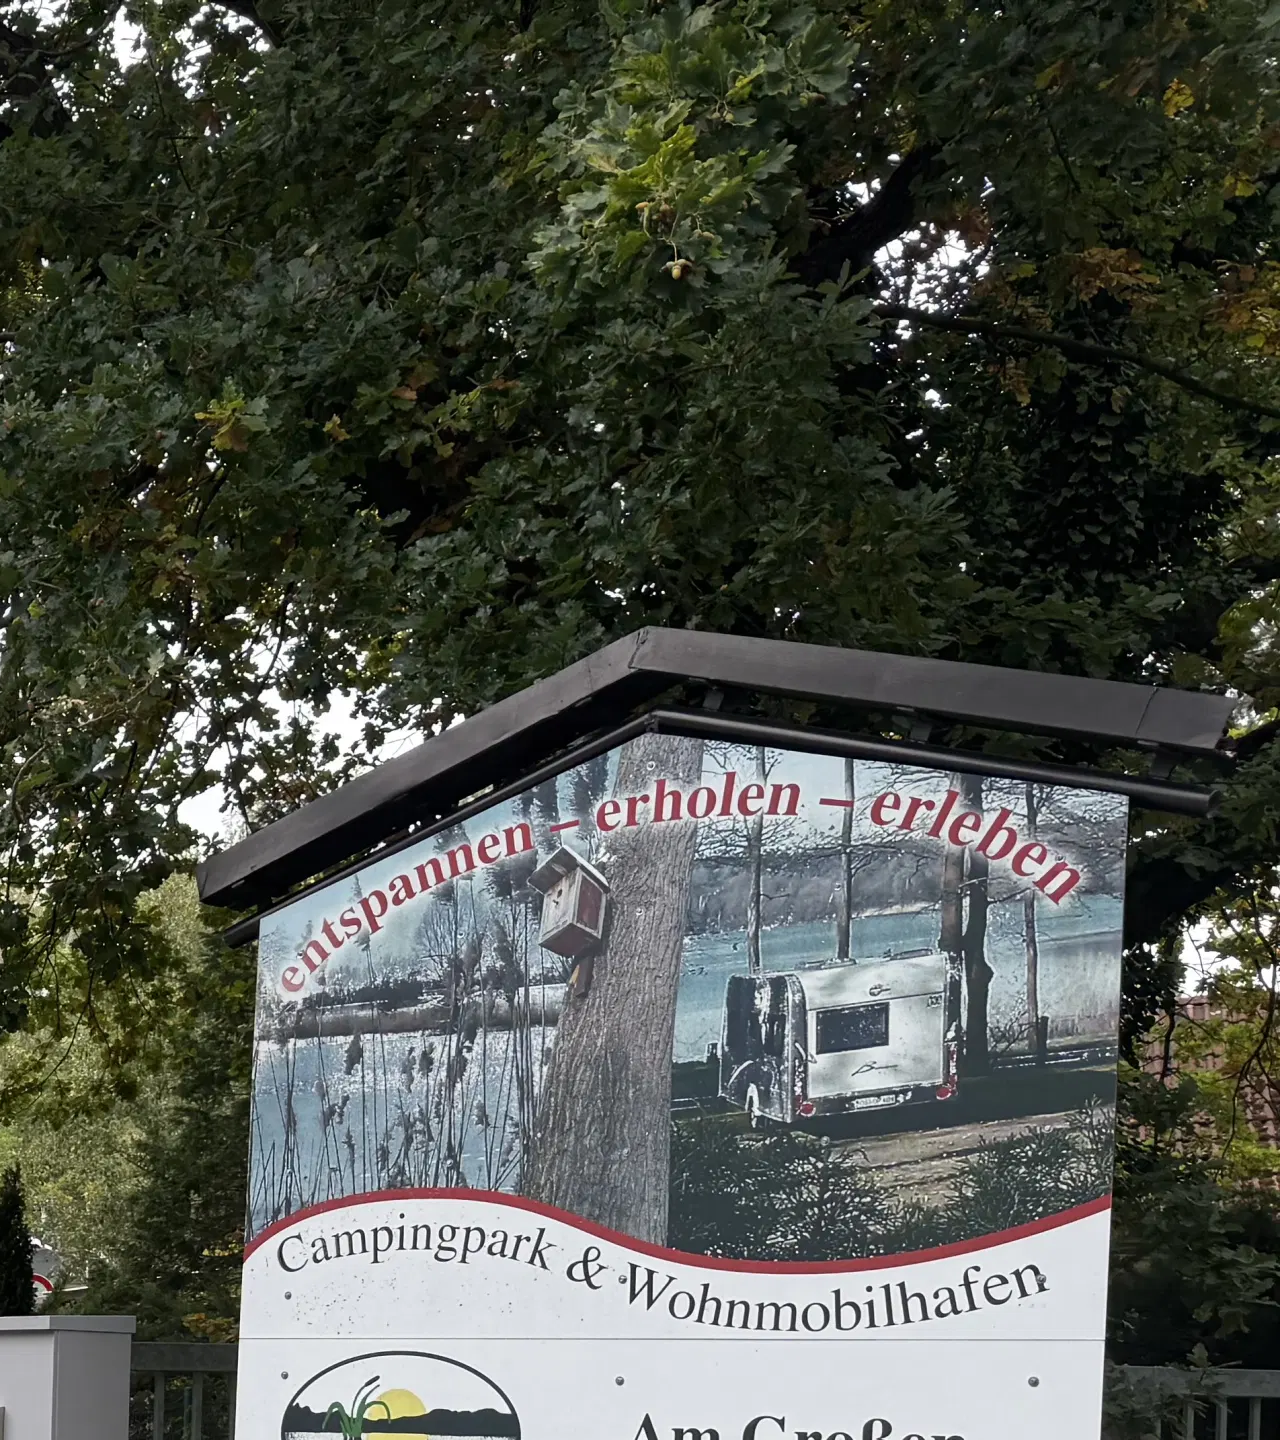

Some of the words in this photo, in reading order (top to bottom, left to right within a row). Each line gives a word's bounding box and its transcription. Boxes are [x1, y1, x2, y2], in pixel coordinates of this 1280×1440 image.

[281, 821, 534, 993] entspannen
[596, 771, 802, 832] erholen
[870, 789, 1082, 905] erleben
[276, 1213, 557, 1272] Campingpark
[566, 1246, 608, 1290] &
[627, 1261, 1051, 1332] Wohnmobilhafen
